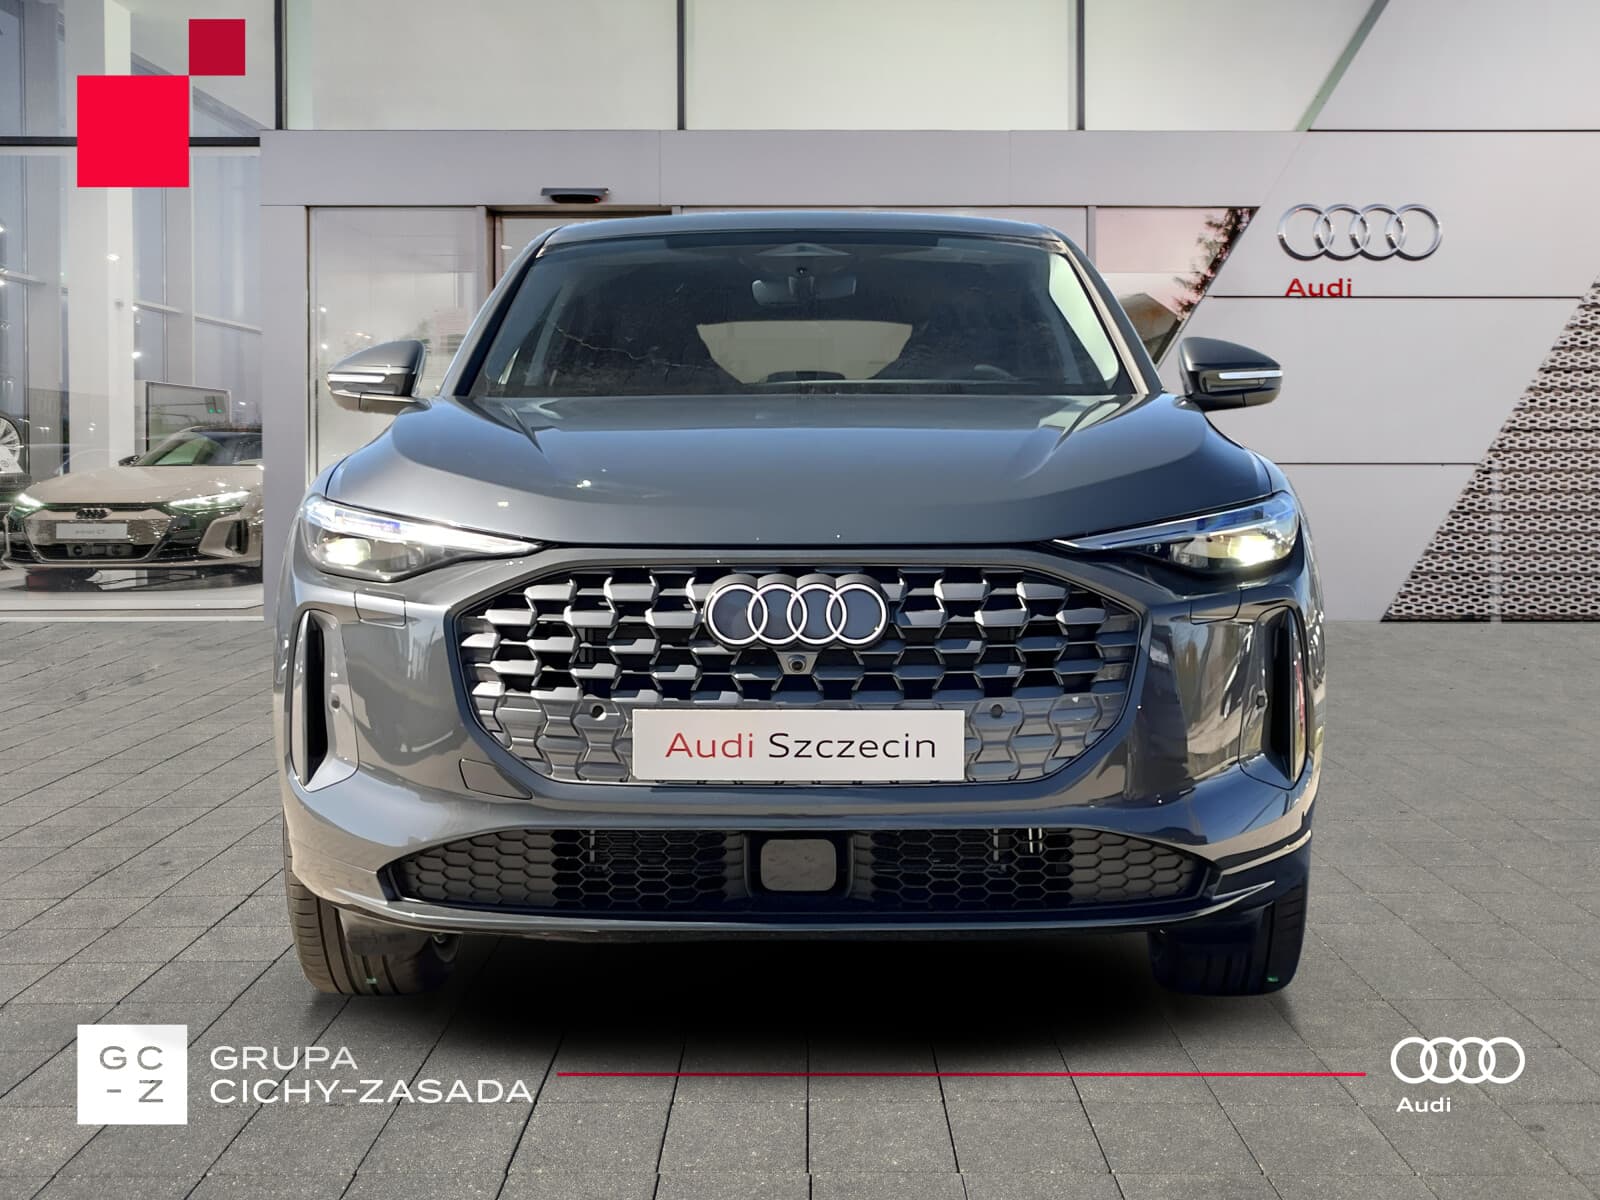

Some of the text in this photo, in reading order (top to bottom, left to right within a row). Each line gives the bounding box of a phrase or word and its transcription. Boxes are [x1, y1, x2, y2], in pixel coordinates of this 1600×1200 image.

[1284, 277, 1353, 297] Audi
[665, 732, 936, 758] Audi Szczecin
